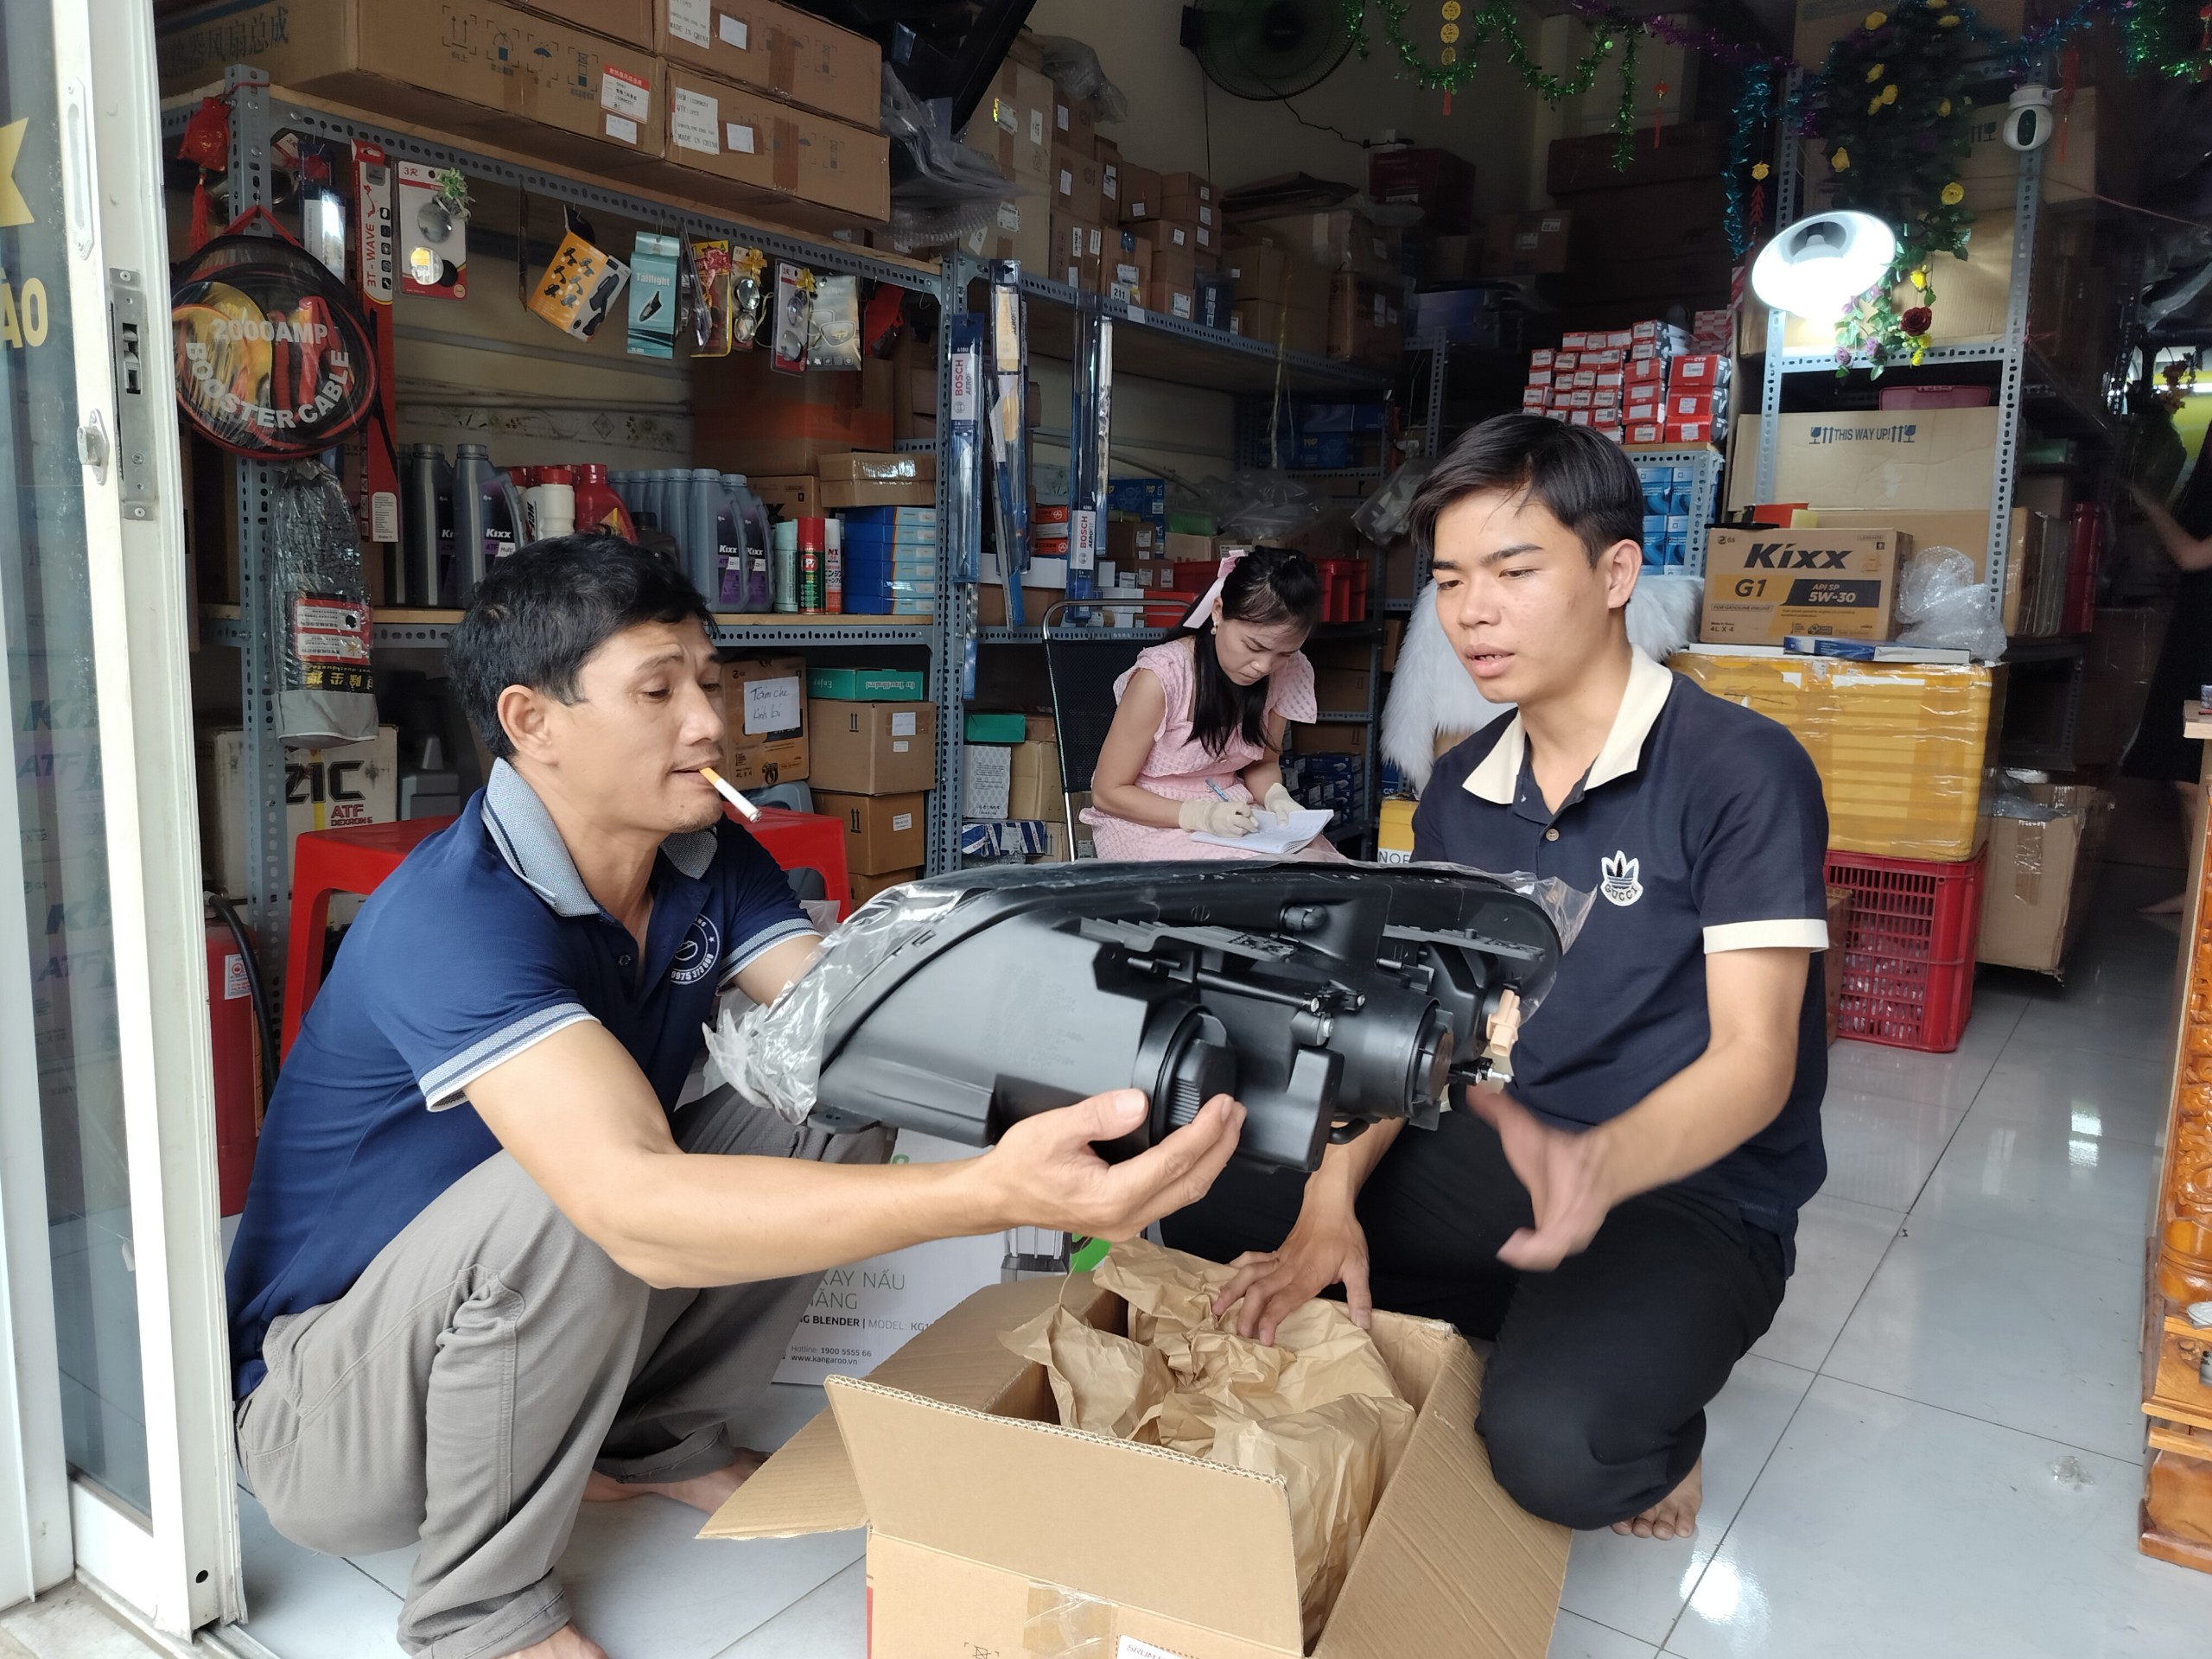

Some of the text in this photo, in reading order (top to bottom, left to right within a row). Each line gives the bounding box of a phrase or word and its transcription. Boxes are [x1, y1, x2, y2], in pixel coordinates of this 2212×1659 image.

[670, 22, 683, 33] MADE
[694, 31, 709, 42] CHINA
[677, 133, 691, 143] MADE
[702, 138, 718, 149] CHINA
[365, 224, 375, 261] WAVE
[636, 273, 671, 286] Taillight
[1114, 288, 1125, 299] 211
[213, 320, 328, 344] 2000AMP
[955, 359, 963, 396] BOSCH
[186, 343, 349, 429] BOOSTER CABLE
[1834, 428, 1891, 441] THIS WAY UP!
[442, 529, 454, 538] Ki
[486, 528, 512, 539] Kixx
[719, 545, 737, 554] Kixx
[1744, 543, 1853, 569] Kixx
[1734, 578, 1767, 598] G1
[1808, 591, 1857, 603] 5W-30
[284, 760, 366, 805] ZIC
[331, 804, 365, 818] ATF
[1605, 883, 1638, 901] GUCCI
[691, 965, 705, 978] 373
[822, 1268, 906, 1291] AY NẤU
[812, 1315, 860, 1327] BLENDER
[868, 1319, 907, 1332] MODEL:
[791, 1345, 820, 1354] Hotline:
[791, 1355, 858, 1366] www.kangaroo.vn
